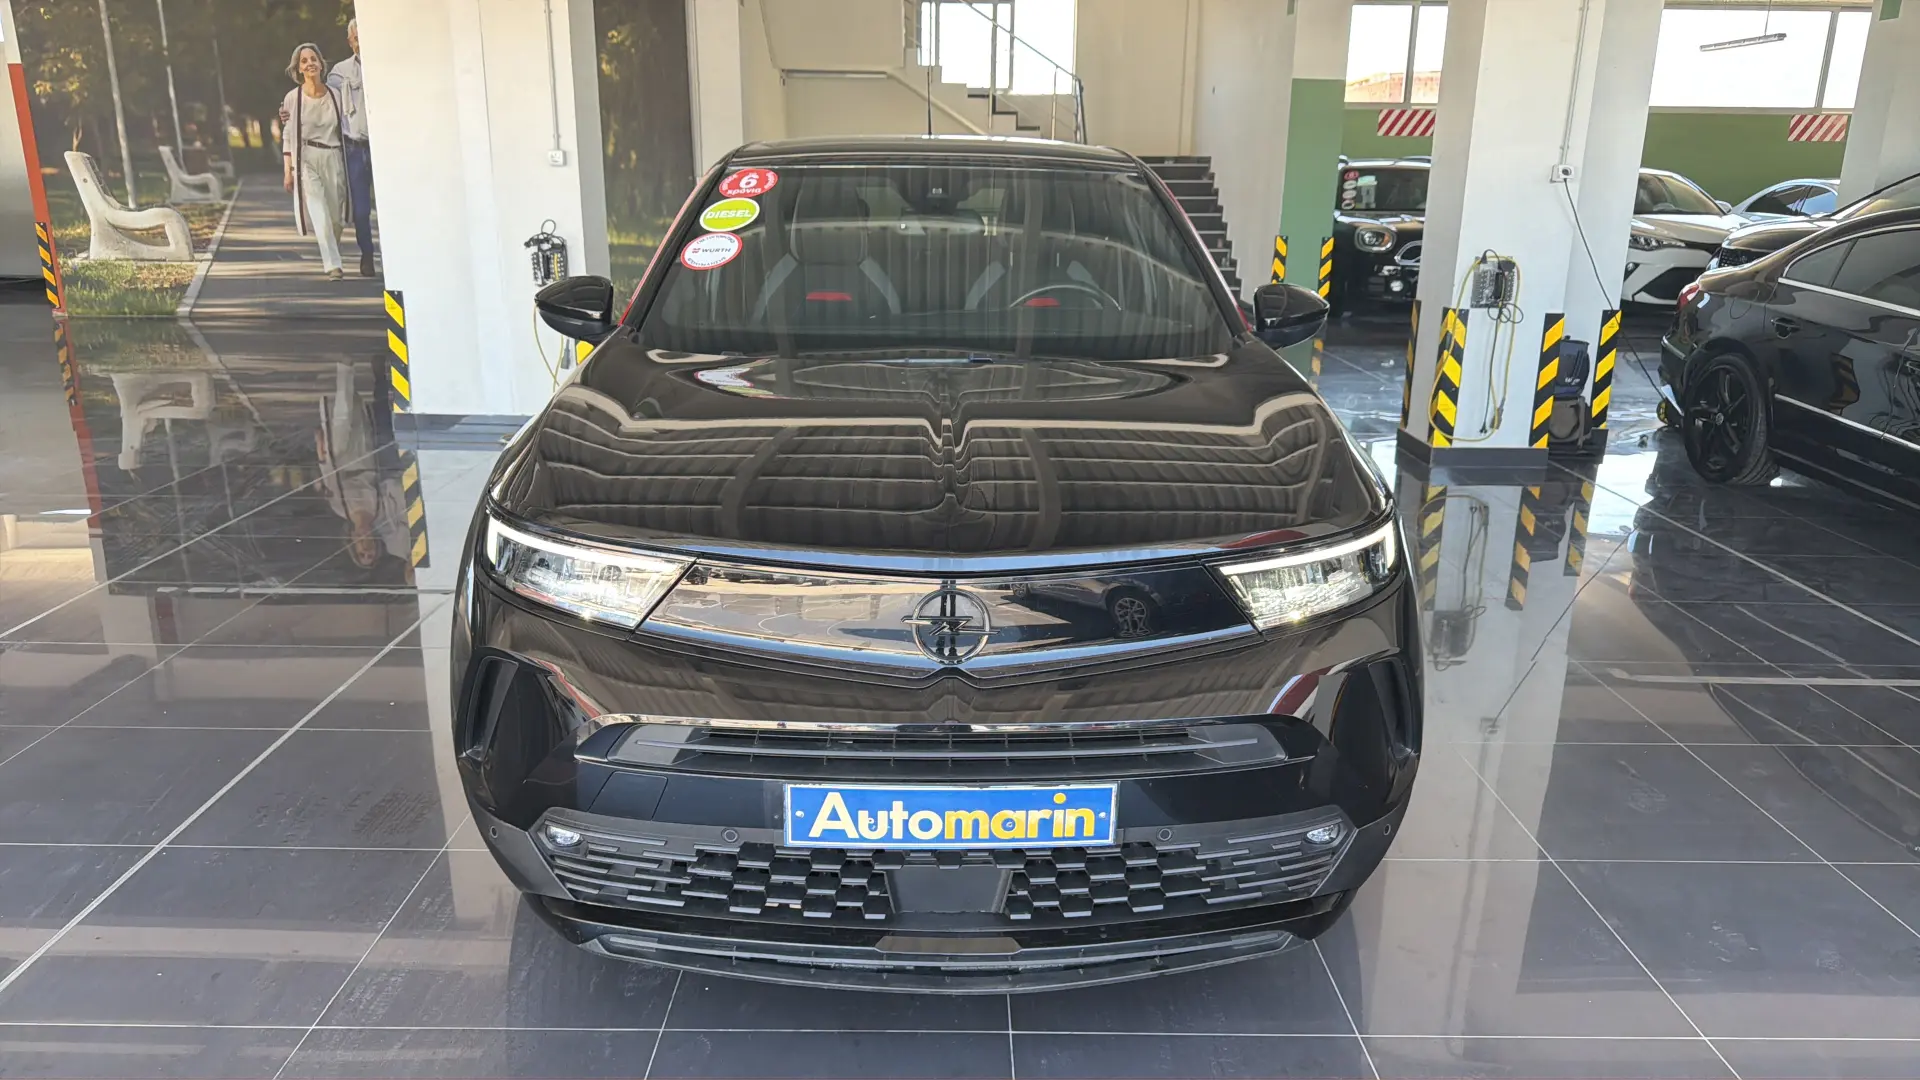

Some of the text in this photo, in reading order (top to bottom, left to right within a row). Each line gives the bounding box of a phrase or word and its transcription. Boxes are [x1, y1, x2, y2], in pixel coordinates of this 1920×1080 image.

[739, 173, 759, 189] 6
[705, 209, 752, 219] DIESEL
[808, 791, 1095, 840] Automarin
